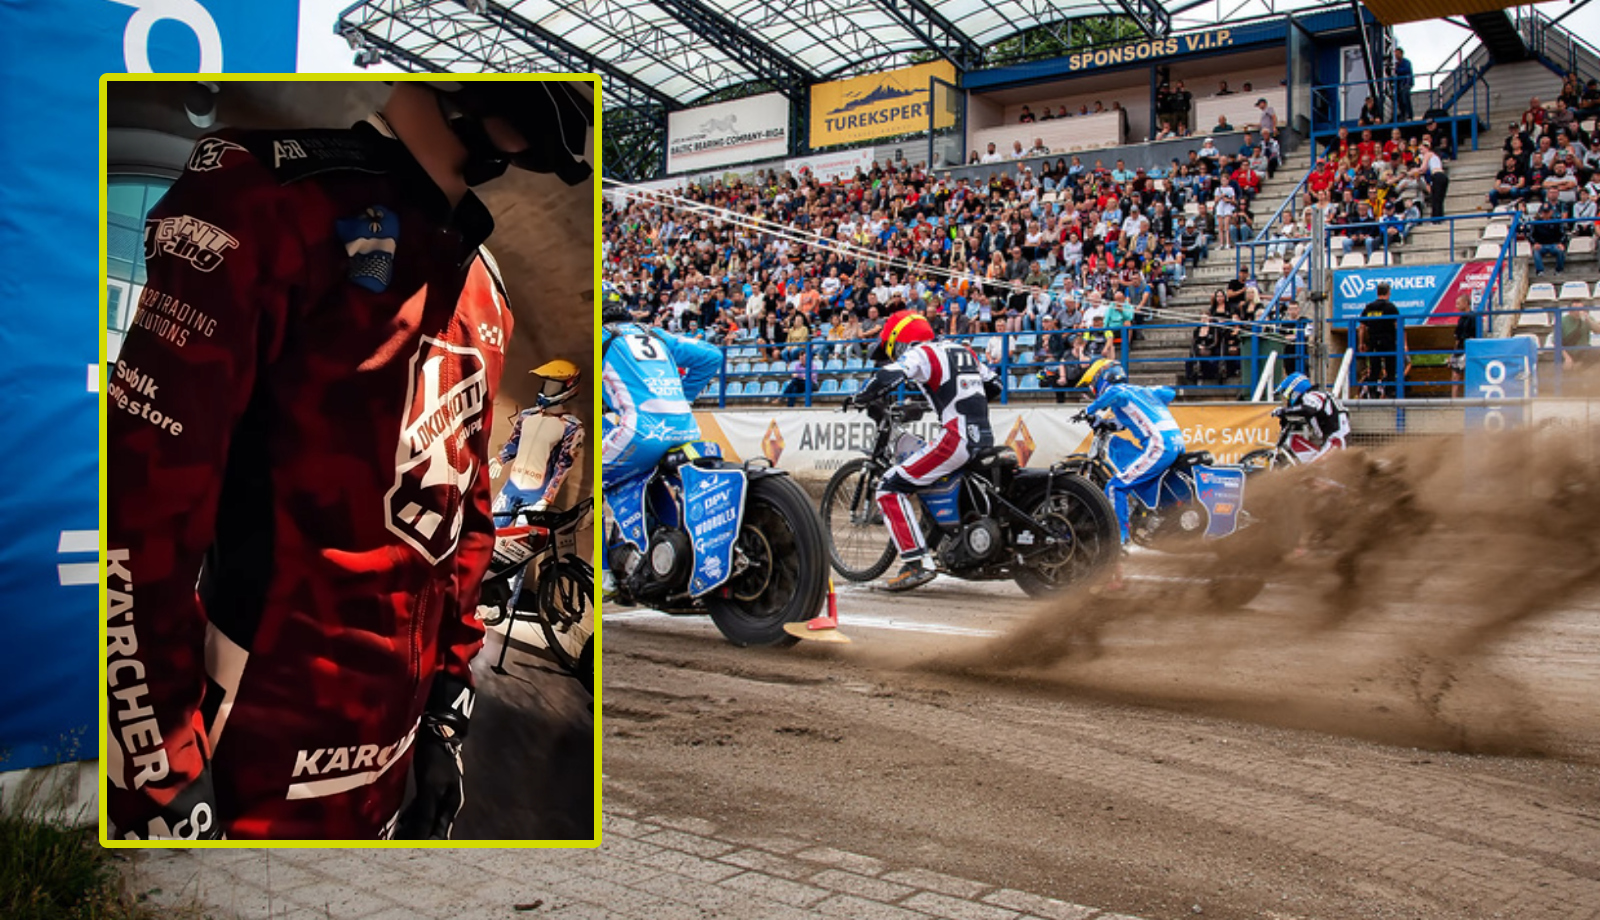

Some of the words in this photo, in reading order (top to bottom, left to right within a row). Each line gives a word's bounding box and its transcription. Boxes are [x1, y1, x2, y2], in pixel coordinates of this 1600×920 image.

[1069, 38, 1178, 71] SPONSORS
[1185, 30, 1233, 51] V.I.P.
[157, 293, 218, 338] TRADING
[635, 335, 657, 359] 3
[955, 352, 973, 367] 11
[410, 380, 485, 459] LOKOMOTI
[800, 422, 876, 451] AMBER
[1221, 428, 1270, 445] SAVU
[107, 548, 170, 790] KÄRCHER
